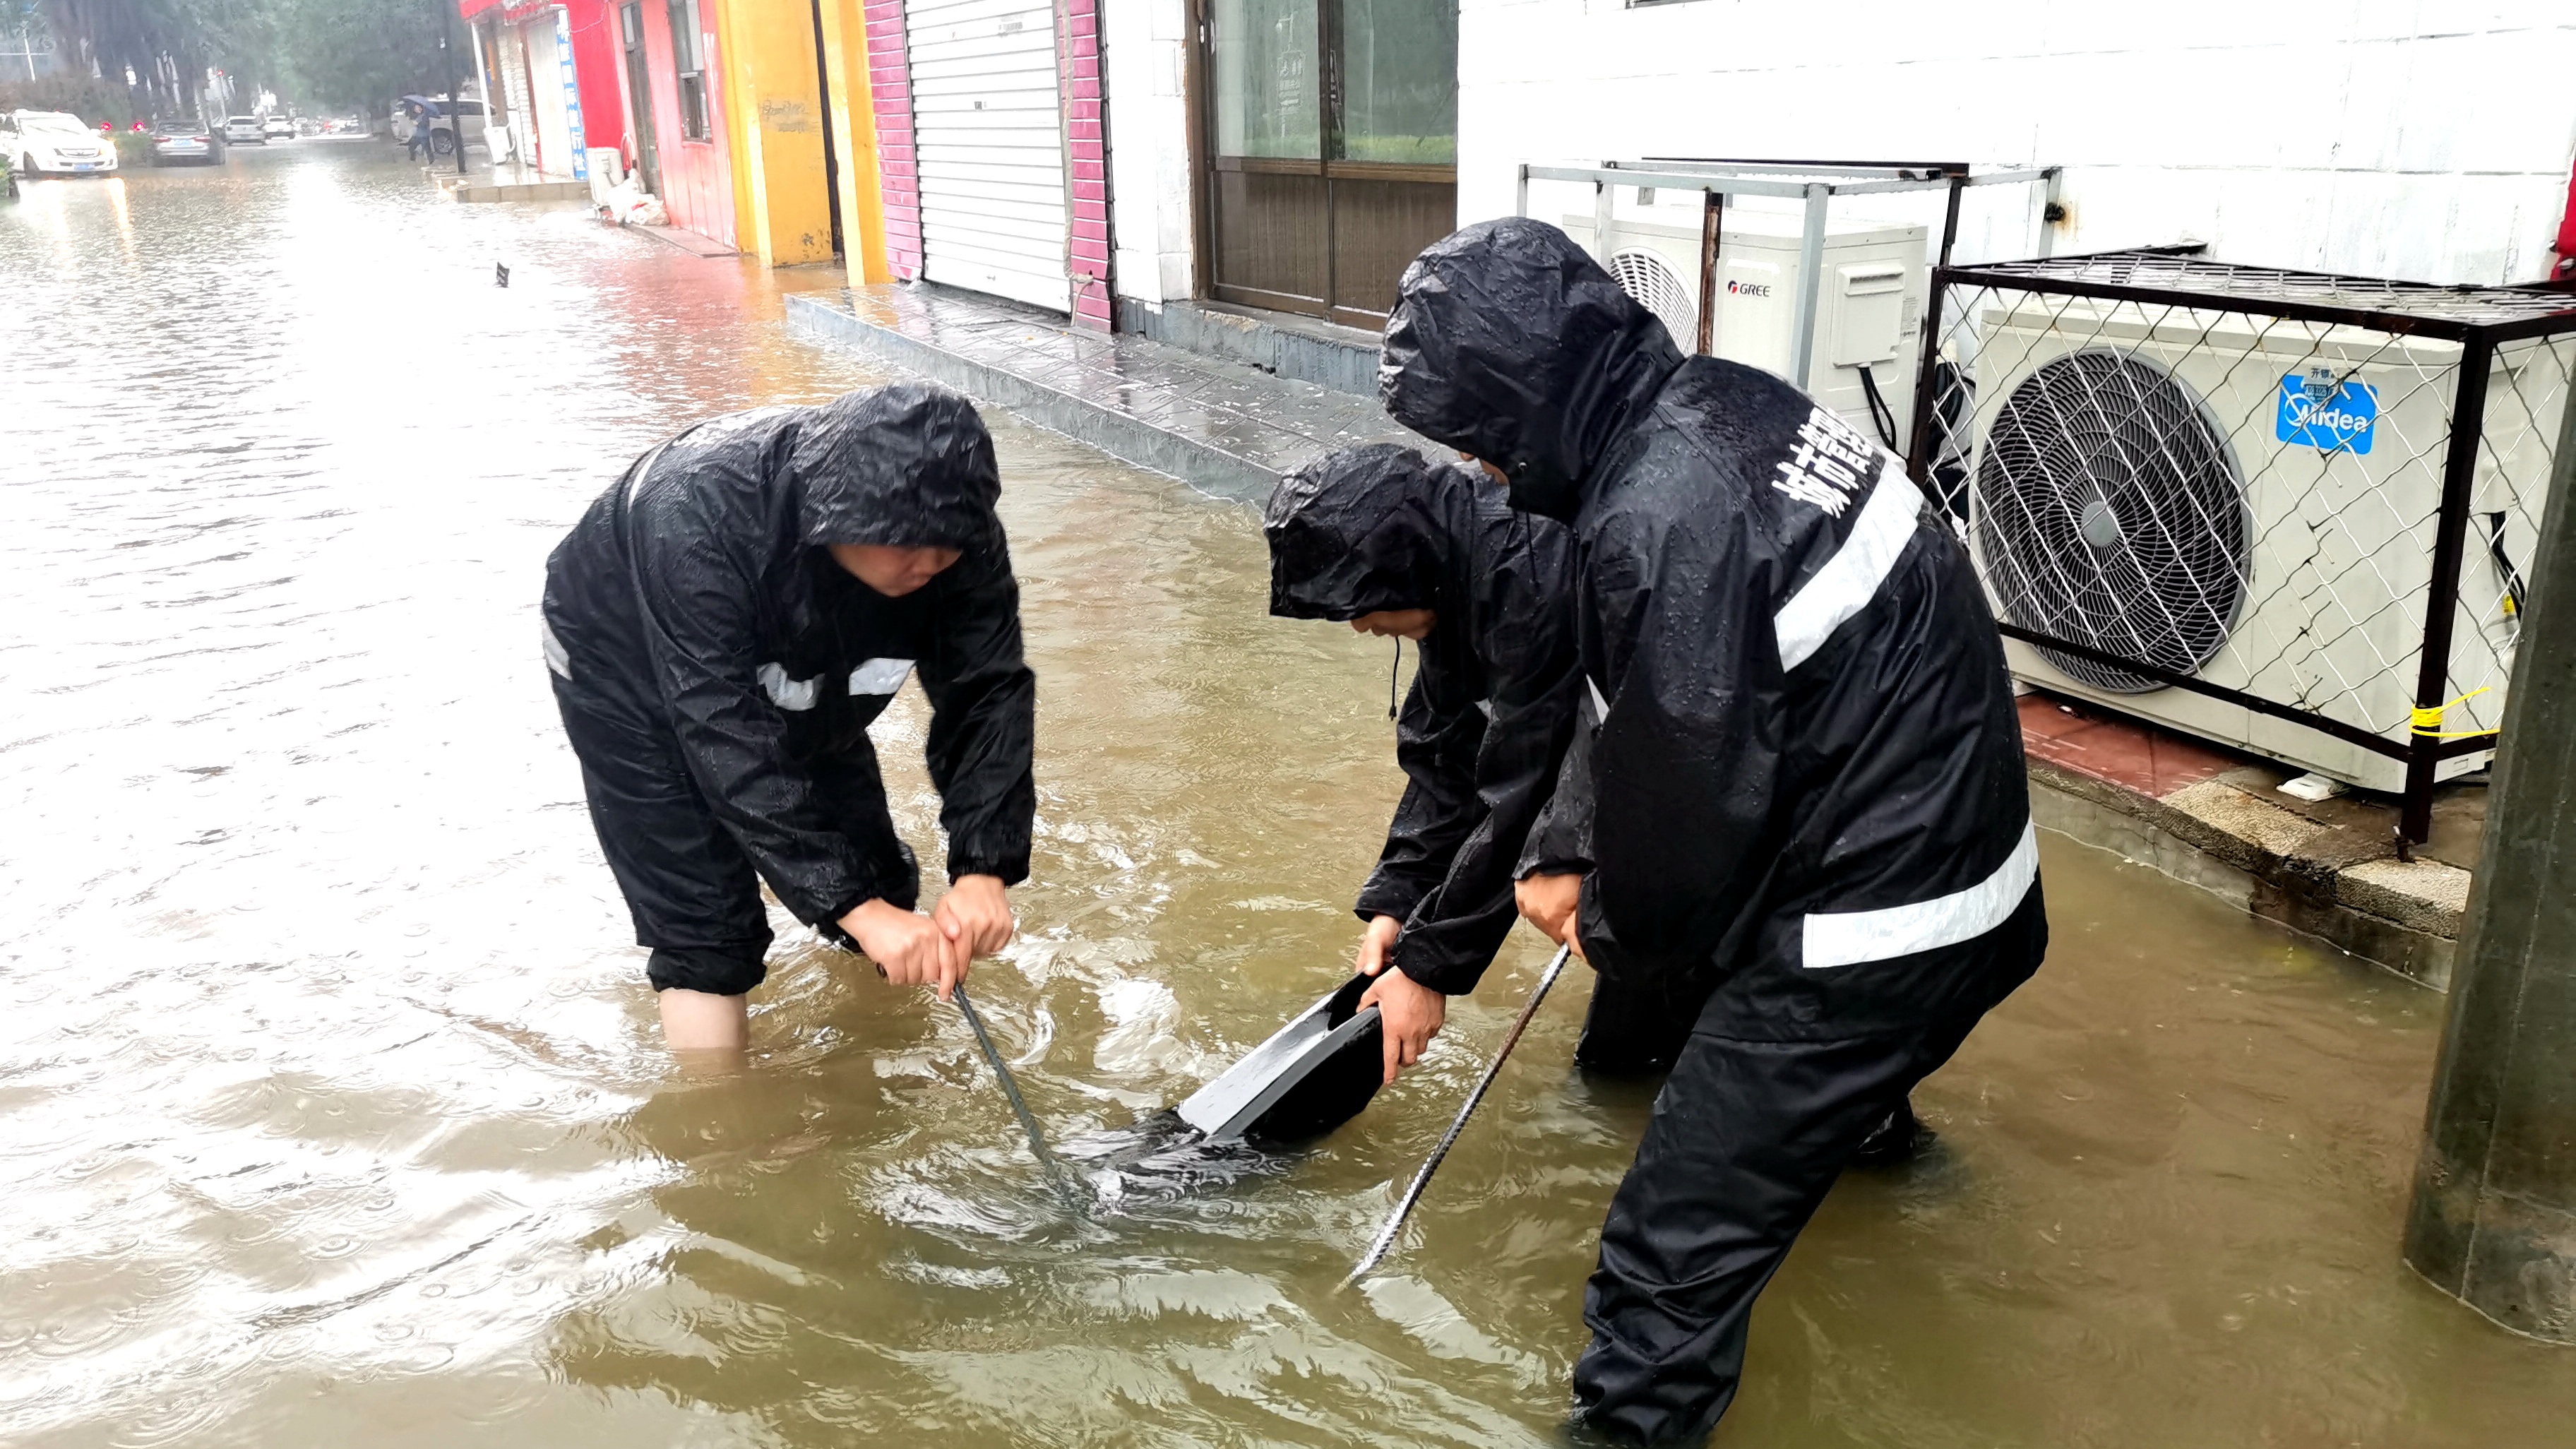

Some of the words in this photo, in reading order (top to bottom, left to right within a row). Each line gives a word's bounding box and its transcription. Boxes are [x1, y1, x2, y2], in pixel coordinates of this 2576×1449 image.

[1739, 282, 1771, 298] GREE
[2296, 403, 2368, 433] Midea
[1771, 403, 1874, 520] 城市管理
